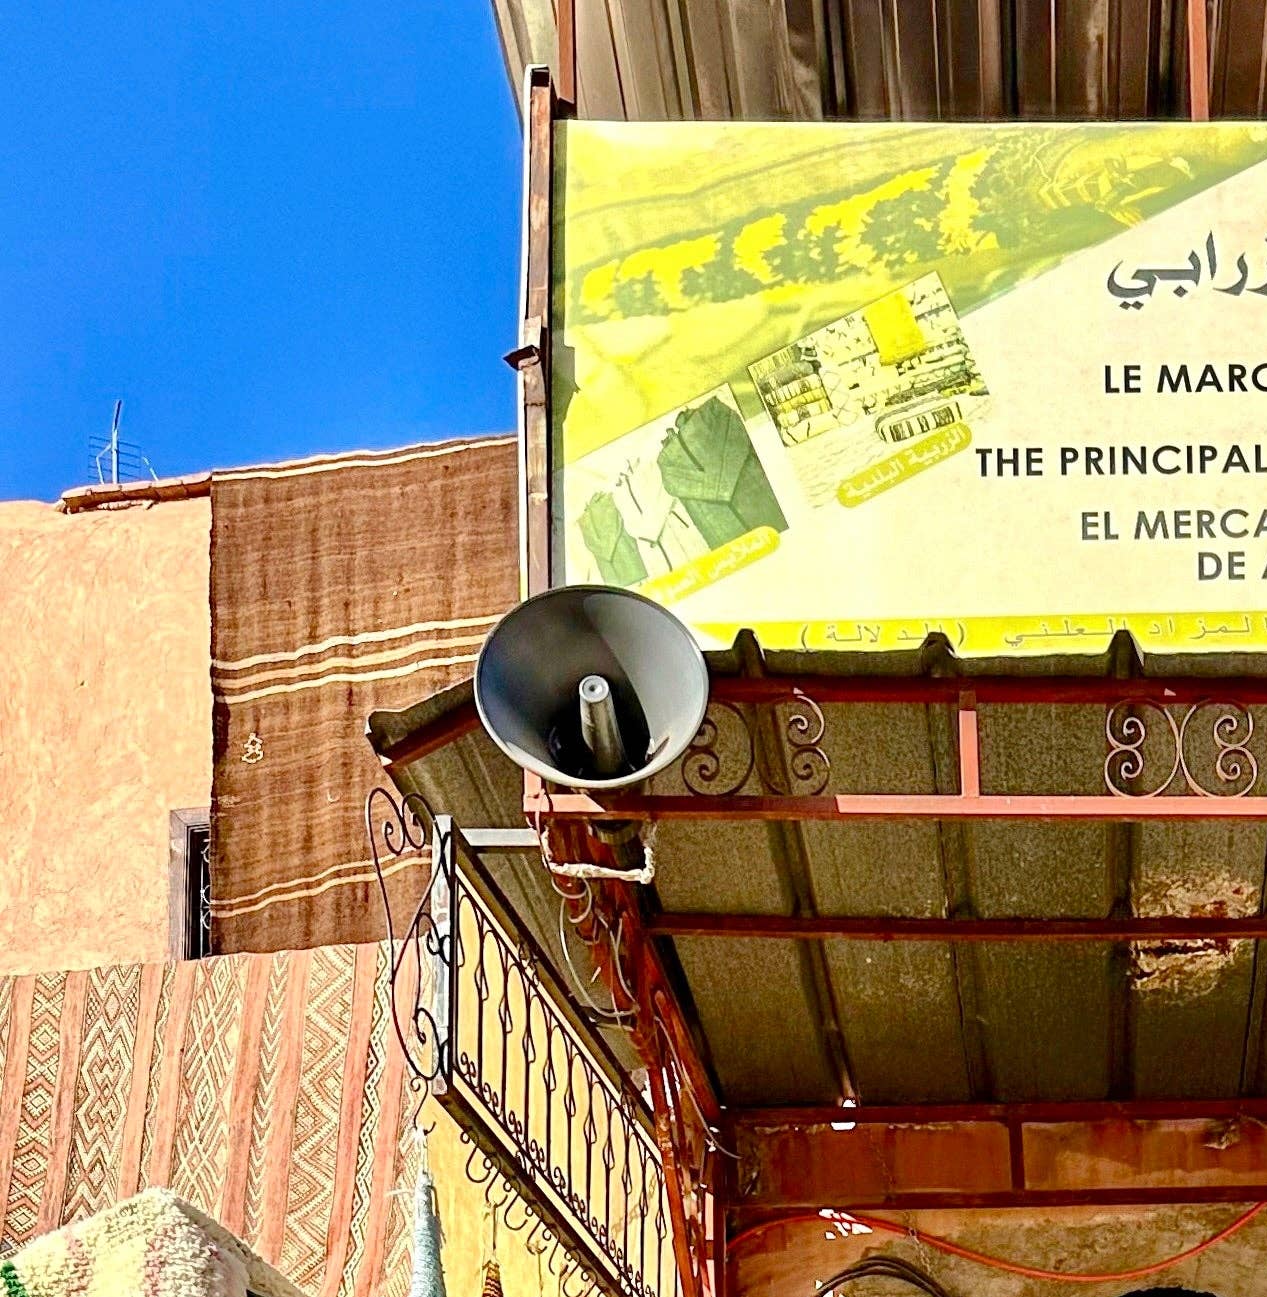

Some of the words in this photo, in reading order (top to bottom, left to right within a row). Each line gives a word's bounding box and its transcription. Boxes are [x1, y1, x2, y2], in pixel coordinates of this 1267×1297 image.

[1105, 365, 1141, 393] LE
[975, 447, 1043, 477] THE
[1081, 511, 1119, 540] EL
[1198, 551, 1246, 581] DE
